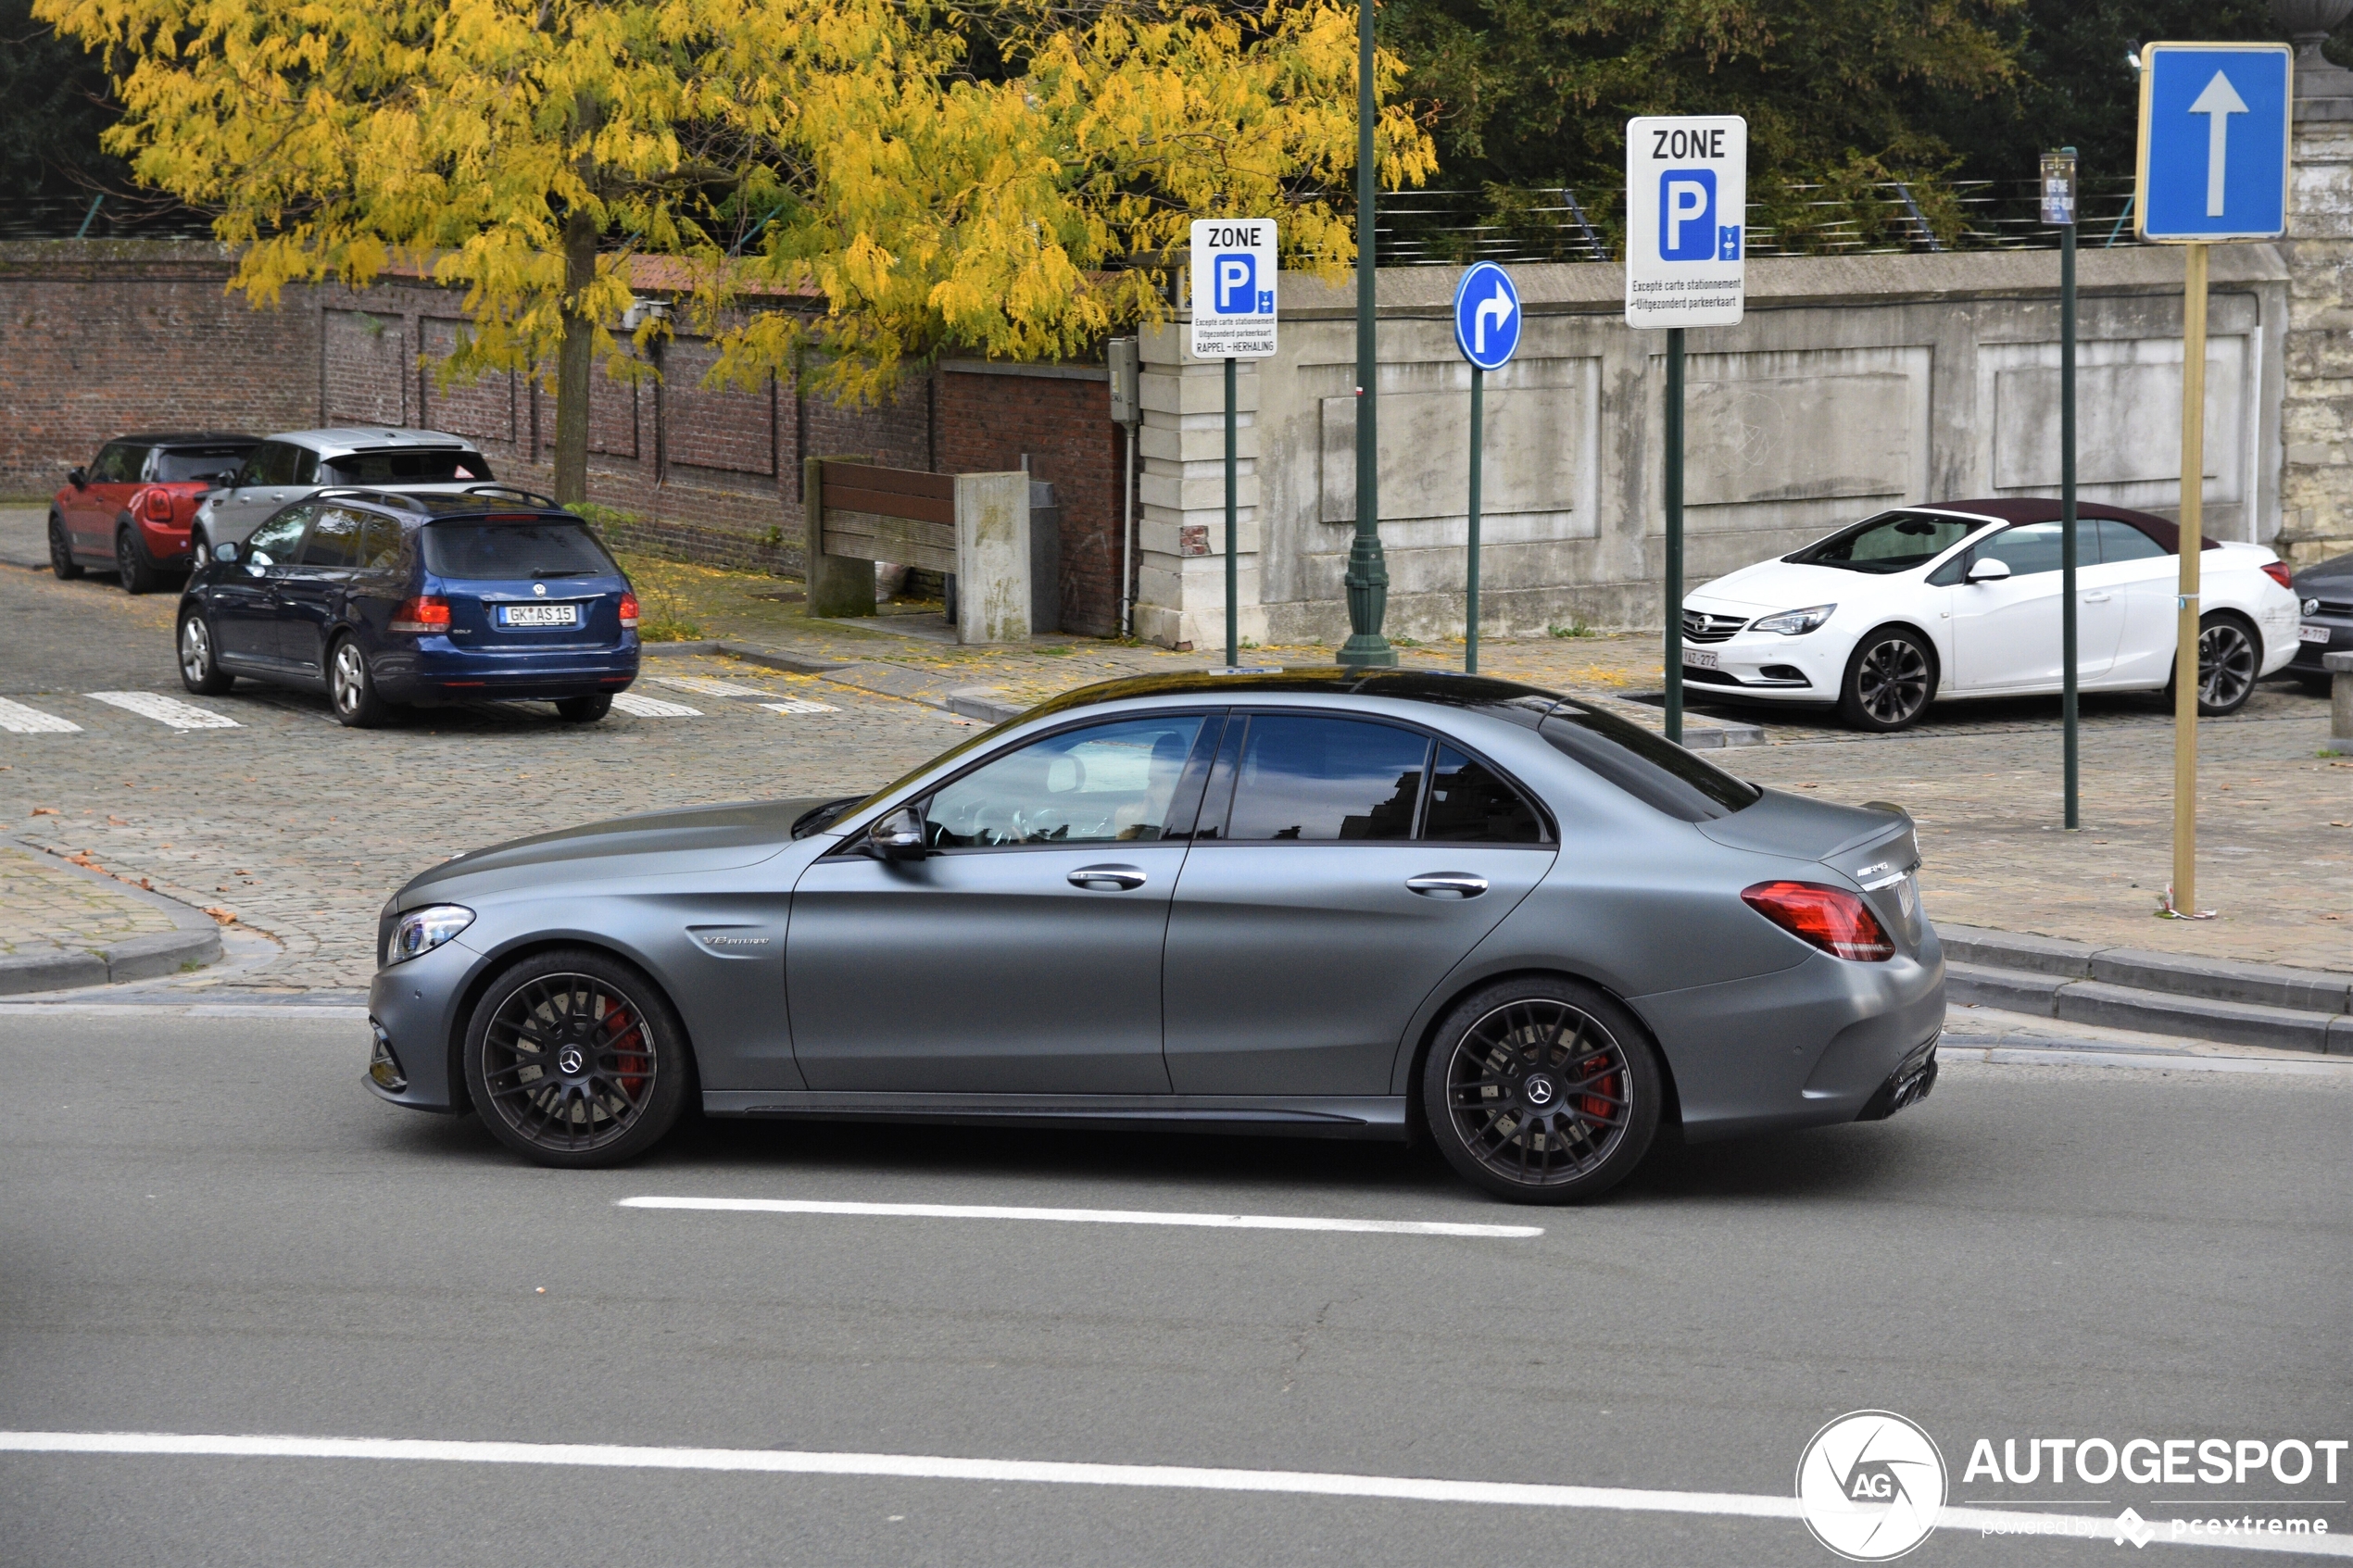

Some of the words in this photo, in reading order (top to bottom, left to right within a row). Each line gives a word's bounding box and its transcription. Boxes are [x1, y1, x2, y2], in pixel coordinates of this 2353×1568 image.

[1653, 129, 1725, 159] ZONE
[1668, 181, 1707, 250] P
[1209, 228, 1261, 246] ZONE
[1221, 261, 1250, 307] P
[1632, 280, 1663, 294] Excepté
[1665, 280, 1684, 291] carte
[1687, 278, 1741, 290] stationnement
[1637, 297, 1686, 312] Uitgezonderd
[1689, 295, 1736, 310] parkeerkaart
[1195, 319, 1217, 327] Excepté
[1199, 330, 1235, 339] Uitgezonderd
[1237, 329, 1271, 338] parkeerkaart
[1197, 343, 1225, 352] RAPPEL
[1233, 341, 1274, 352] HERHALING
[510, 608, 528, 621] GK
[536, 608, 552, 620] AS
[556, 608, 571, 620] 15
